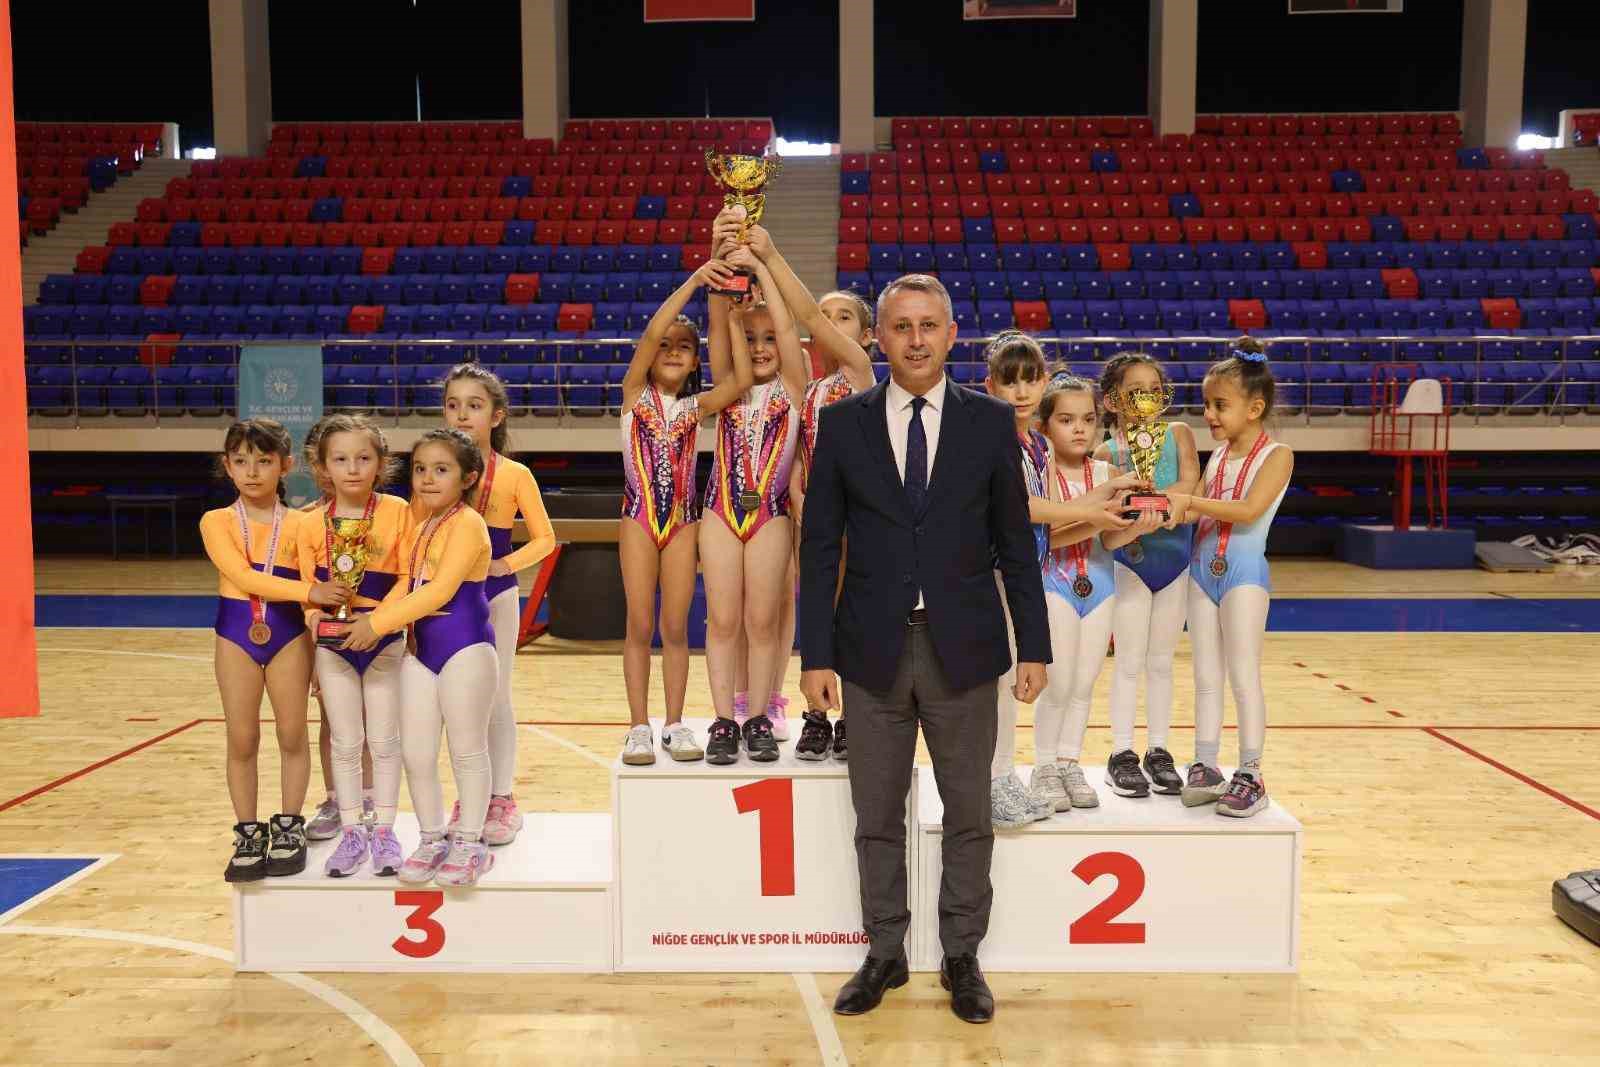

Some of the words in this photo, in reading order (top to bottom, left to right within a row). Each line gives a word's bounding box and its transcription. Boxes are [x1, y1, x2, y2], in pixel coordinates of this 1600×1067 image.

[733, 779, 794, 896] 1
[393, 891, 446, 958] 3
[1069, 851, 1145, 944] 2
[652, 932, 688, 945] NİĞDE
[690, 932, 739, 946] GENÇLİK
[741, 933, 756, 945] VE
[758, 933, 789, 945] SPOR
[792, 932, 802, 945] İL
[804, 931, 869, 945] MÜDÜRLÜĞ
